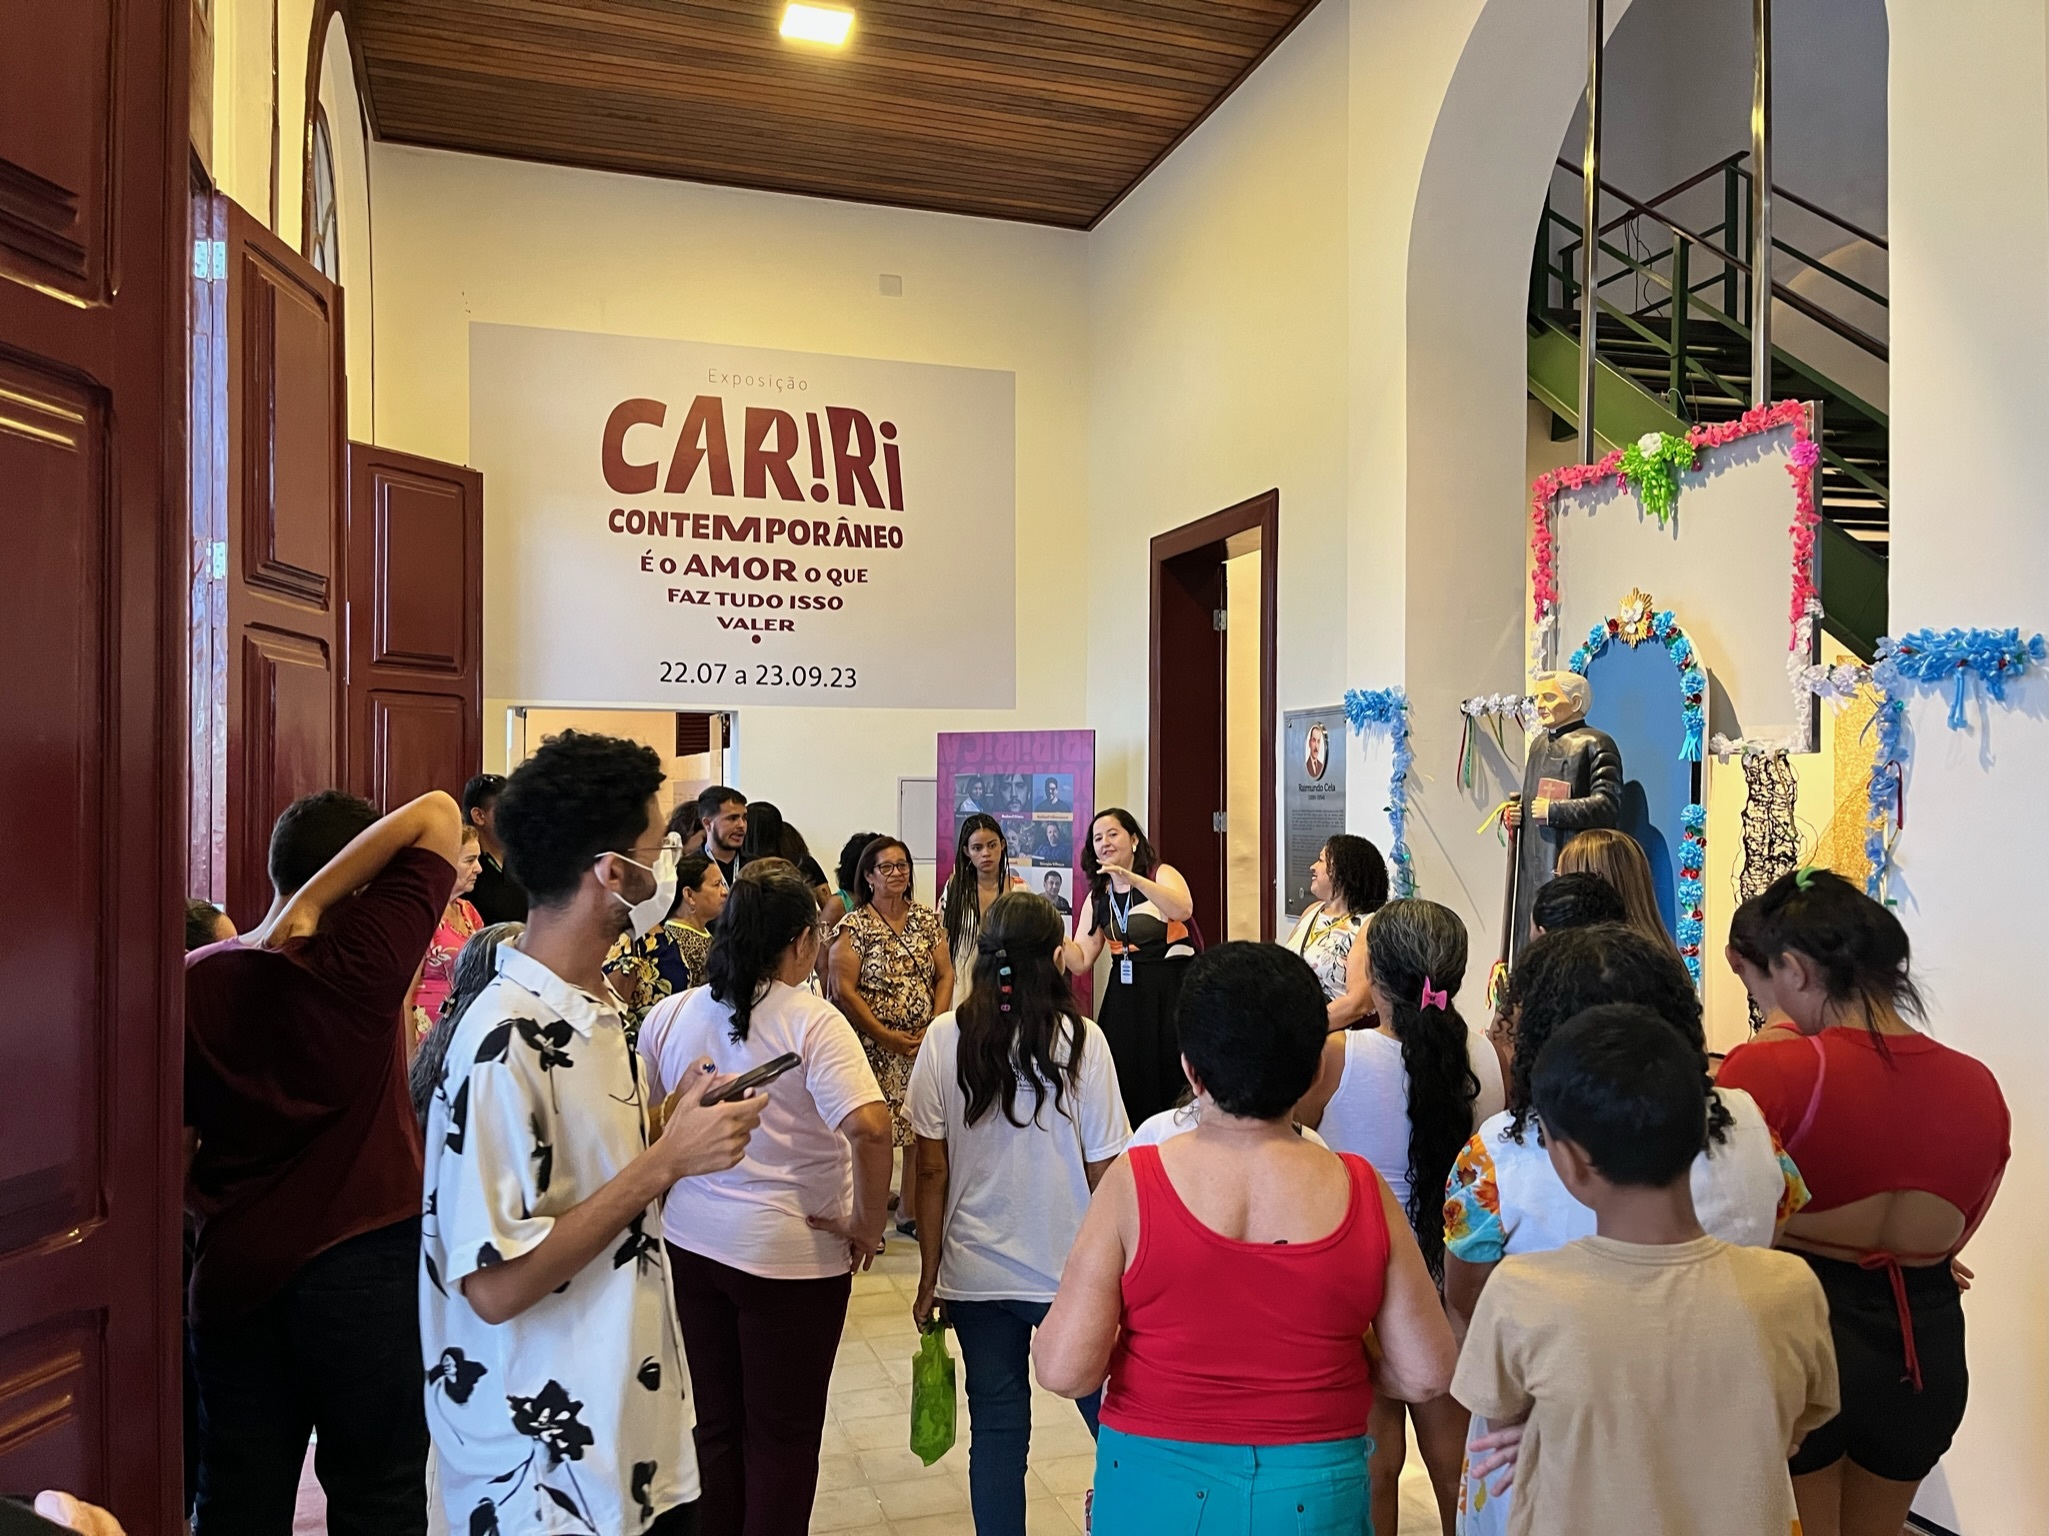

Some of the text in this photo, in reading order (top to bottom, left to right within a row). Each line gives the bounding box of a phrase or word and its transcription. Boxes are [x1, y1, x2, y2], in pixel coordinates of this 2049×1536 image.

[707, 368, 809, 393] Exposição
[608, 508, 904, 549] CONTEMPORÂNEO
[640, 549, 653, 573] É
[682, 553, 799, 583] AMOR
[826, 567, 869, 588] QUE
[667, 587, 844, 611] FAZ TUDO ISSO
[716, 616, 796, 633] VALER
[659, 660, 857, 689] 22.07 a 23.09.23
